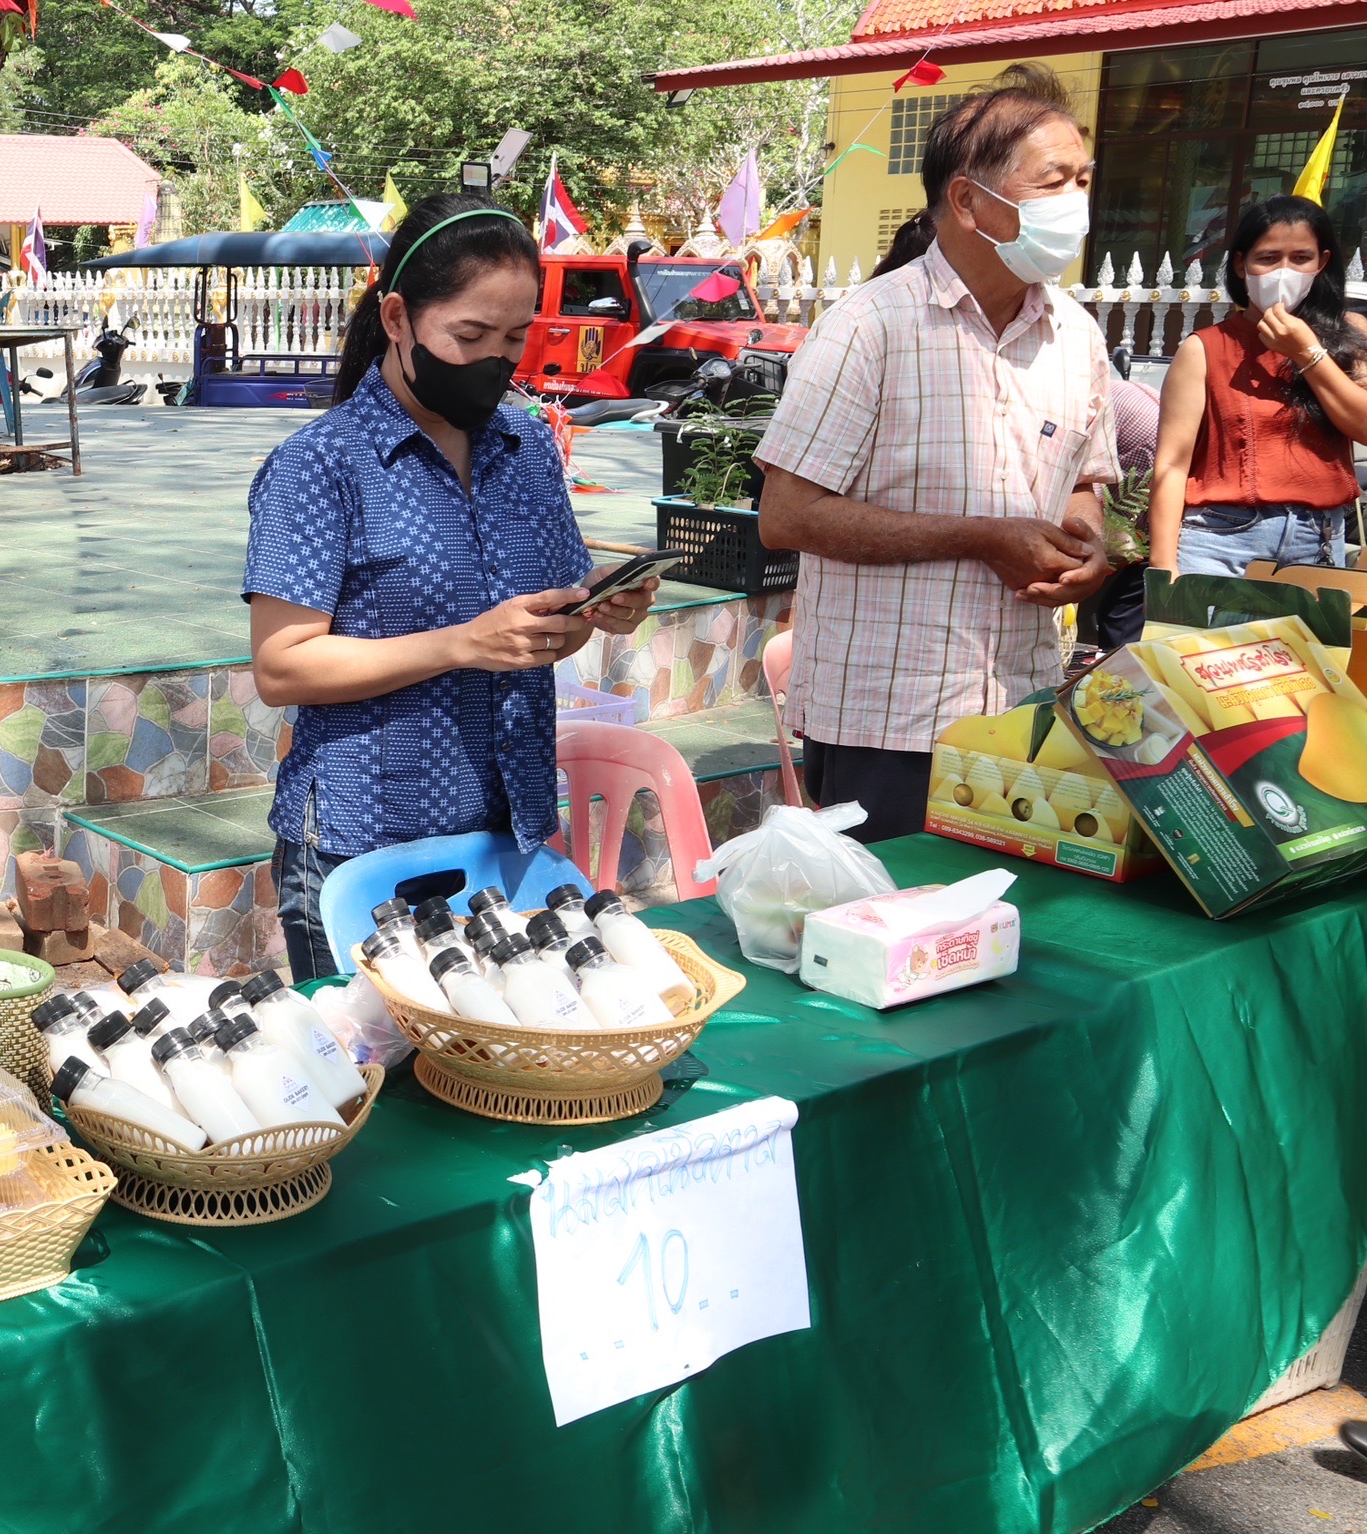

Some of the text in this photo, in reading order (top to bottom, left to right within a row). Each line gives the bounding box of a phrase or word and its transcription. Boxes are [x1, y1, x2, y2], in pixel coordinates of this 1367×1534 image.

[1300, 83, 1350, 95] และครอบครัว
